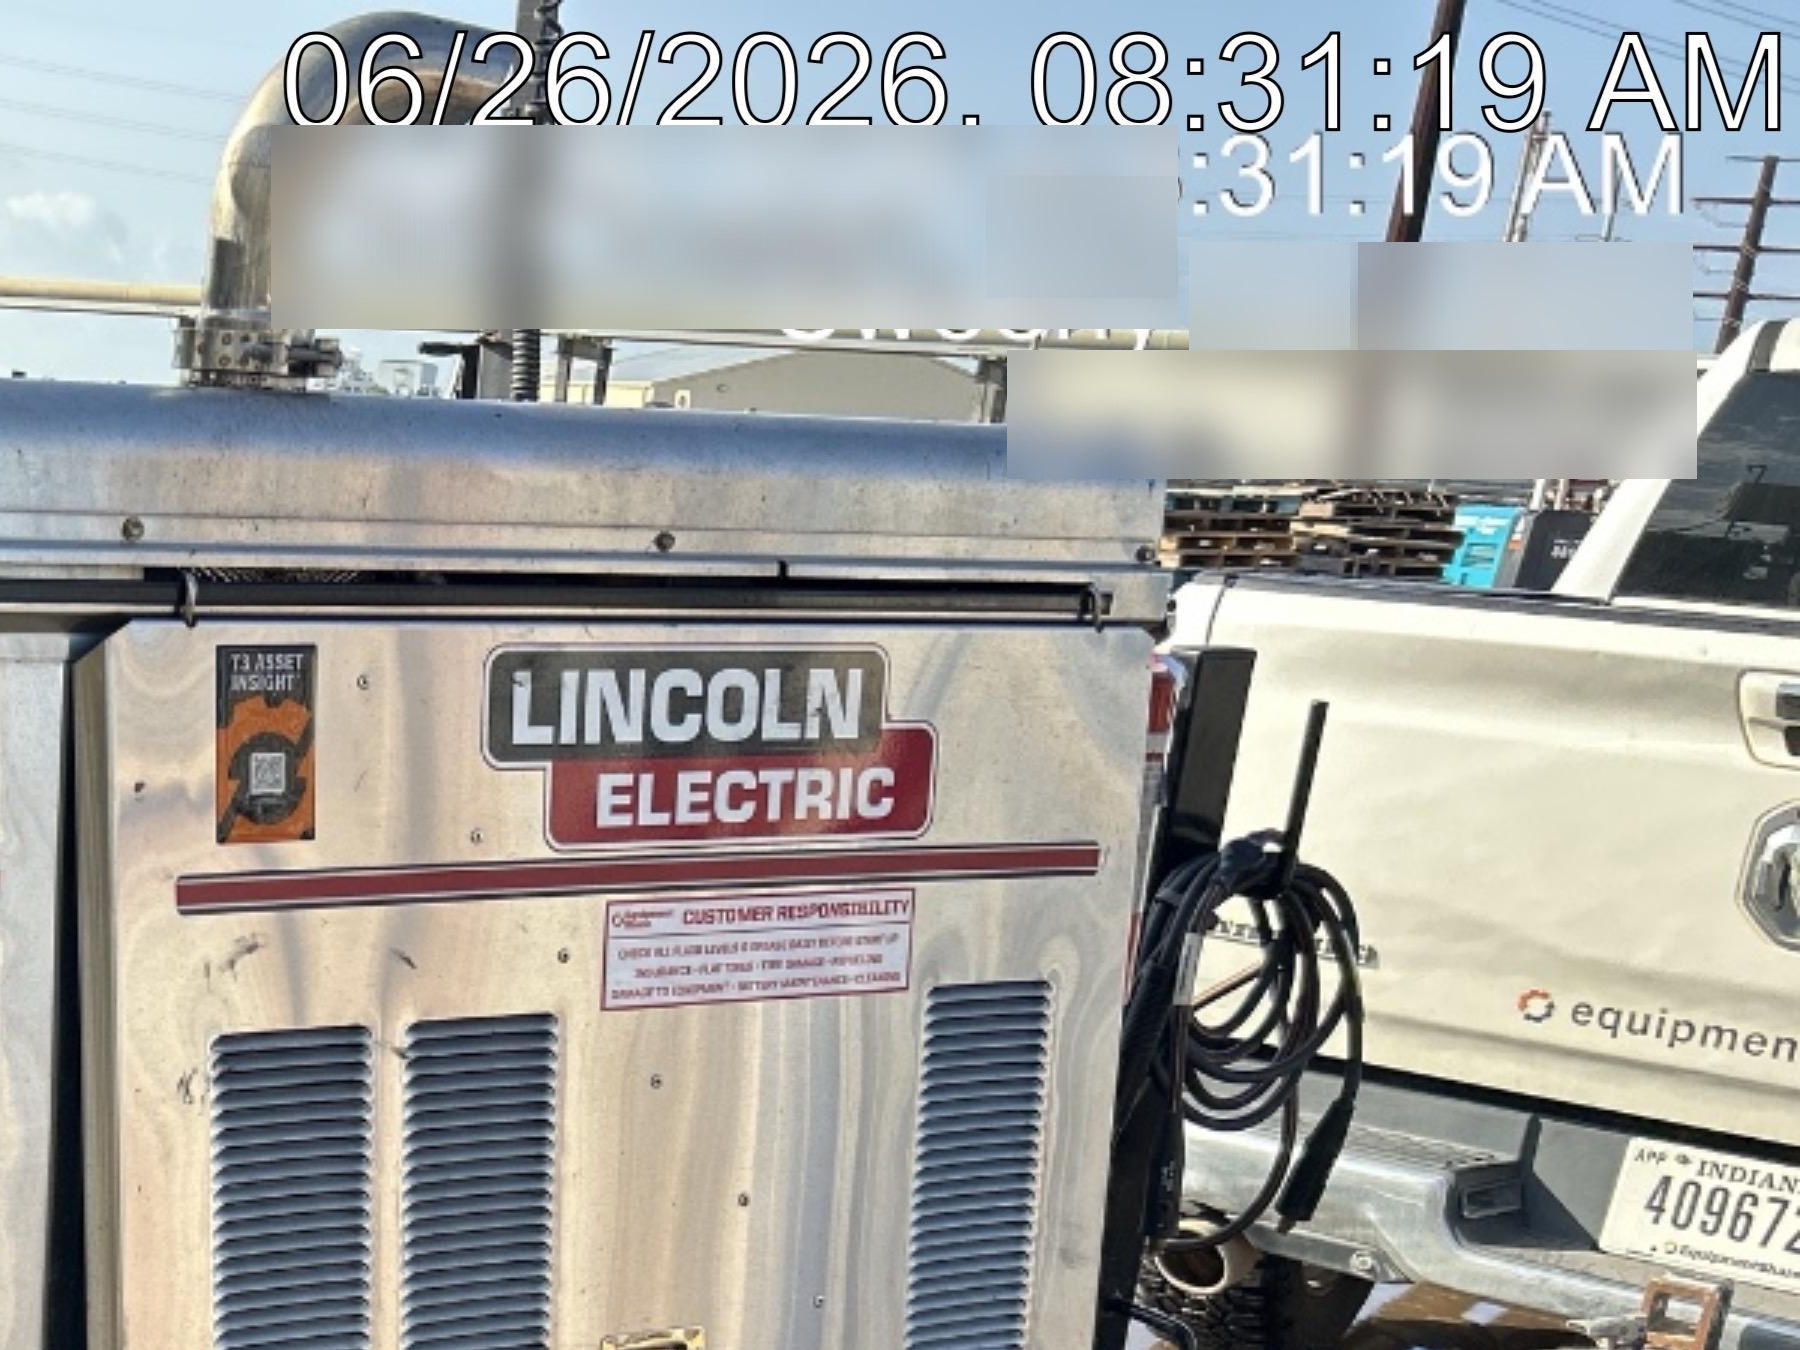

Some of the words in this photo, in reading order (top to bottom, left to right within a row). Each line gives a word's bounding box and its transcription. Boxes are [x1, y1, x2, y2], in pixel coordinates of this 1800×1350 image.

[231, 653, 250, 671] T3
[255, 653, 304, 671] ASSET
[512, 667, 863, 745] LINCOLN
[596, 766, 896, 828] ELECTRIC
[683, 906, 774, 925] CUSTOMER
[777, 900, 909, 922] RESPONSIBILITY
